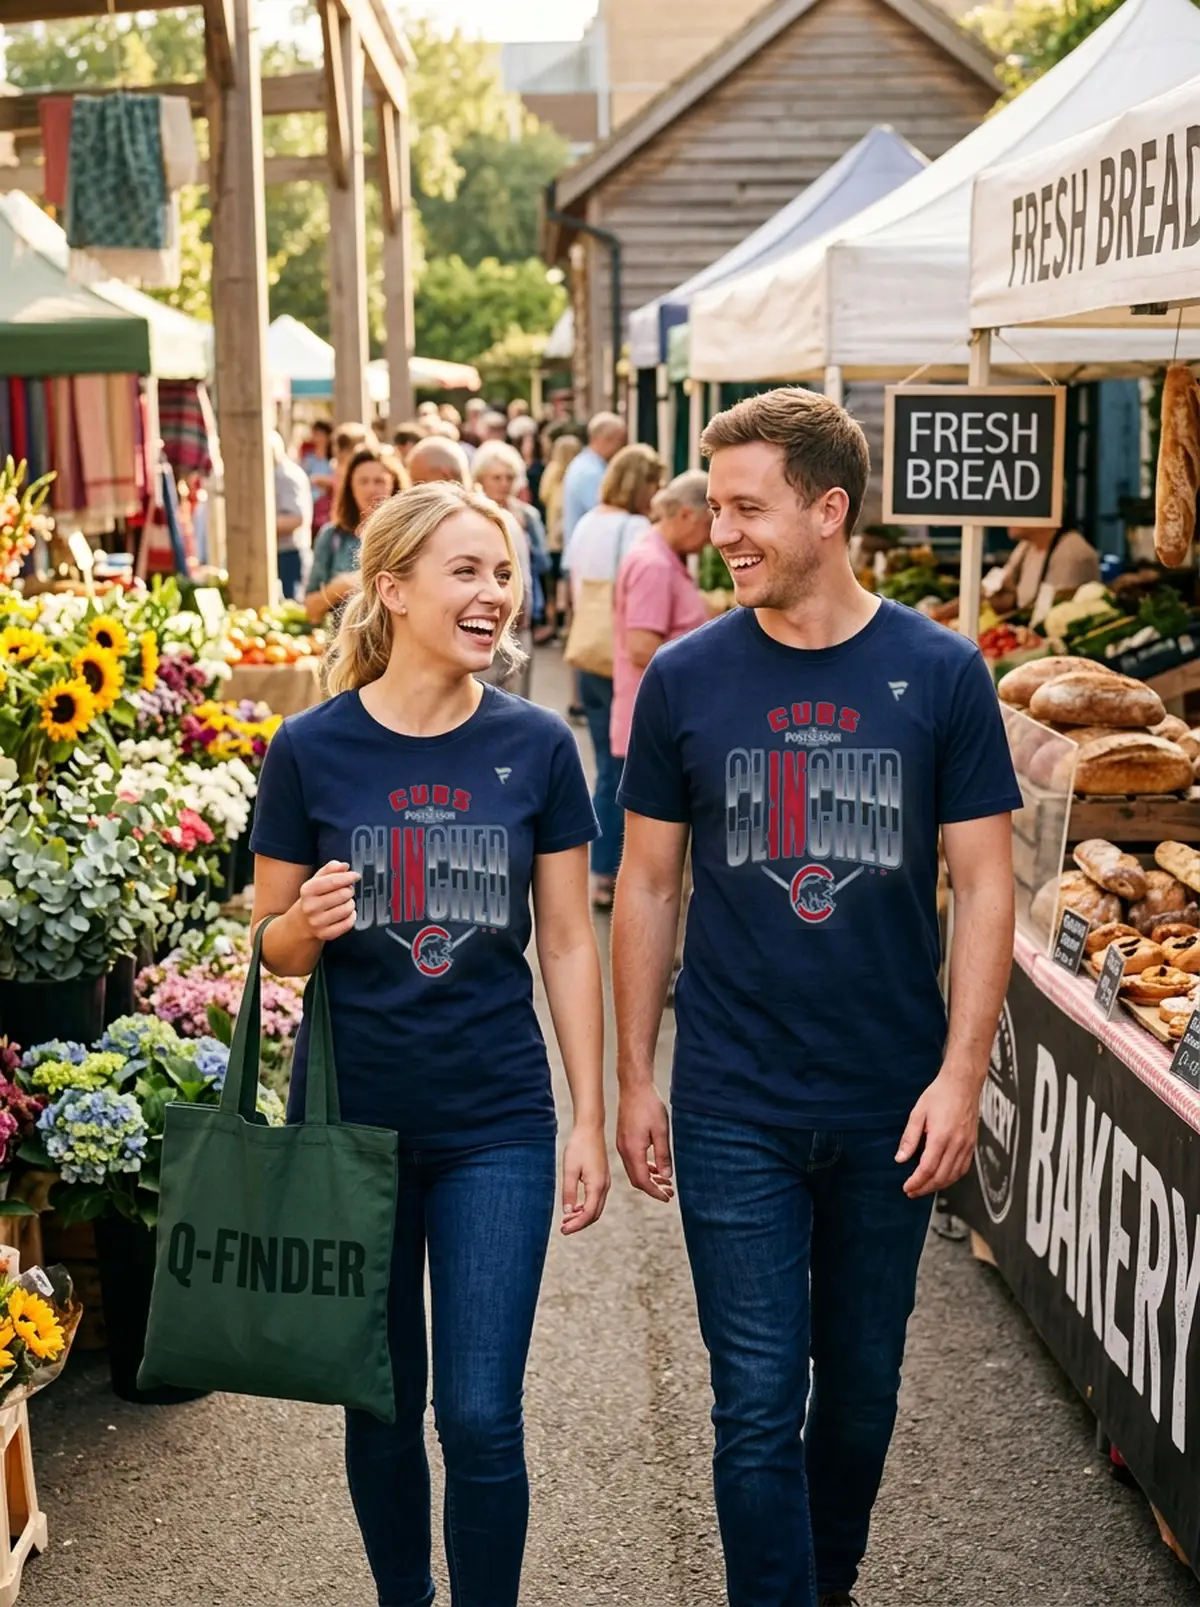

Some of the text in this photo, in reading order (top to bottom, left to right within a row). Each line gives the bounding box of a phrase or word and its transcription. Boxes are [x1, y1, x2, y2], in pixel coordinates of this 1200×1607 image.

[1008, 125, 1200, 288] FRESH BREAD
[910, 412, 1038, 454] FRESH
[906, 458, 1041, 501] BREAD
[767, 701, 860, 733] CUBS
[784, 731, 842, 744] POSTSEASON
[388, 784, 472, 812] CUBS
[725, 747, 902, 870] CLINCHED
[351, 824, 510, 931] CLINCHED
[168, 1222, 366, 1298] Q-FINDER
[1026, 1043, 1200, 1454] BAKERY
